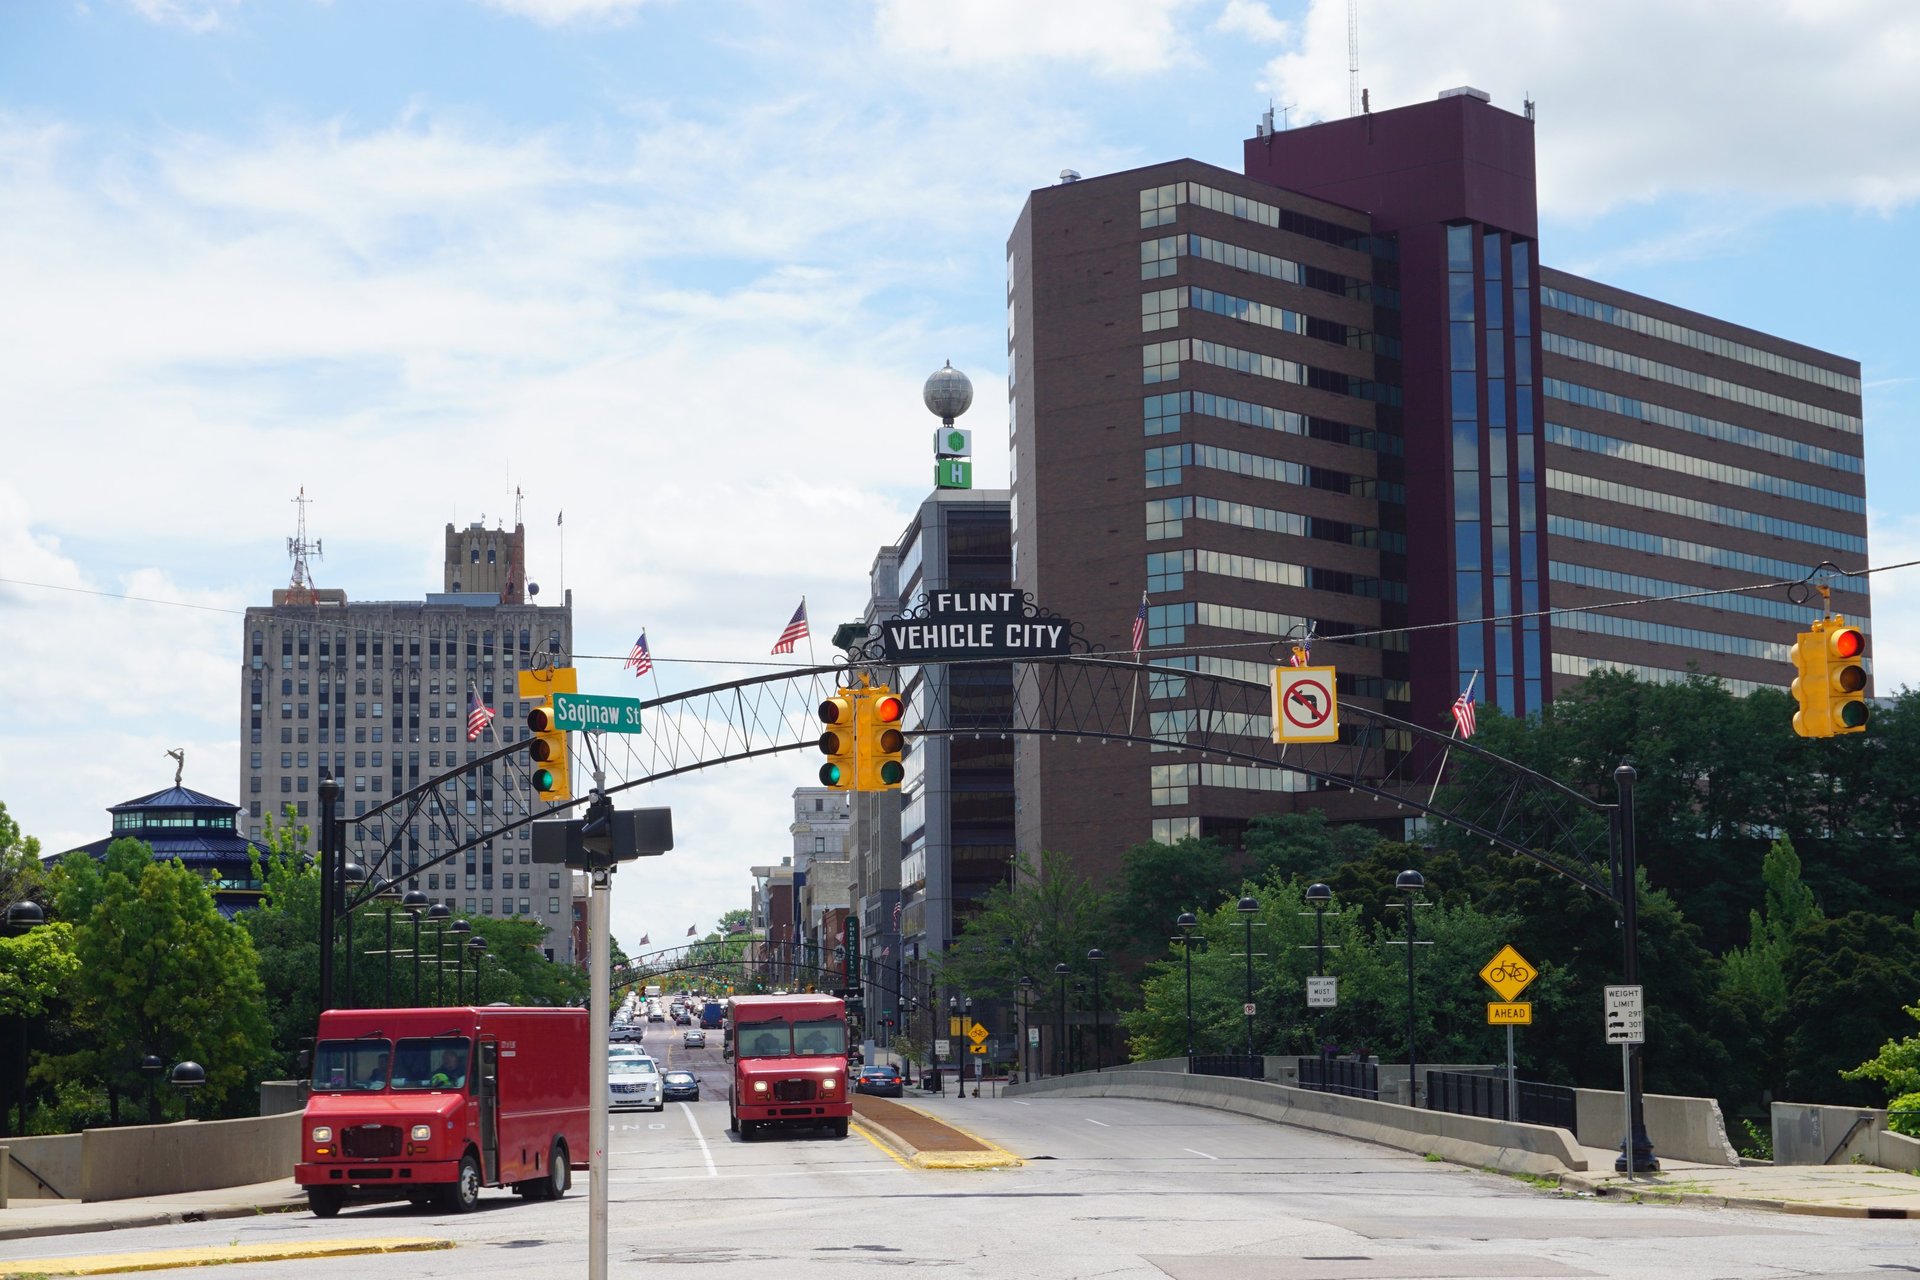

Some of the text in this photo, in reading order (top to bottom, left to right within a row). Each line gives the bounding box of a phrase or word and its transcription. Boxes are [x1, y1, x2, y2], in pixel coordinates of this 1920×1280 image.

[951, 463, 963, 484] H
[937, 593, 1015, 612] FLINT
[890, 624, 1063, 650] VEHICLE CITY
[558, 697, 640, 730] Saginaw St
[1608, 990, 1639, 998] WEIGHT
[1613, 1000, 1635, 1008] LIMIT
[1494, 1008, 1526, 1019] AHEAD
[1628, 1010, 1642, 1018] 29T
[1628, 1031, 1643, 1039] 37T
